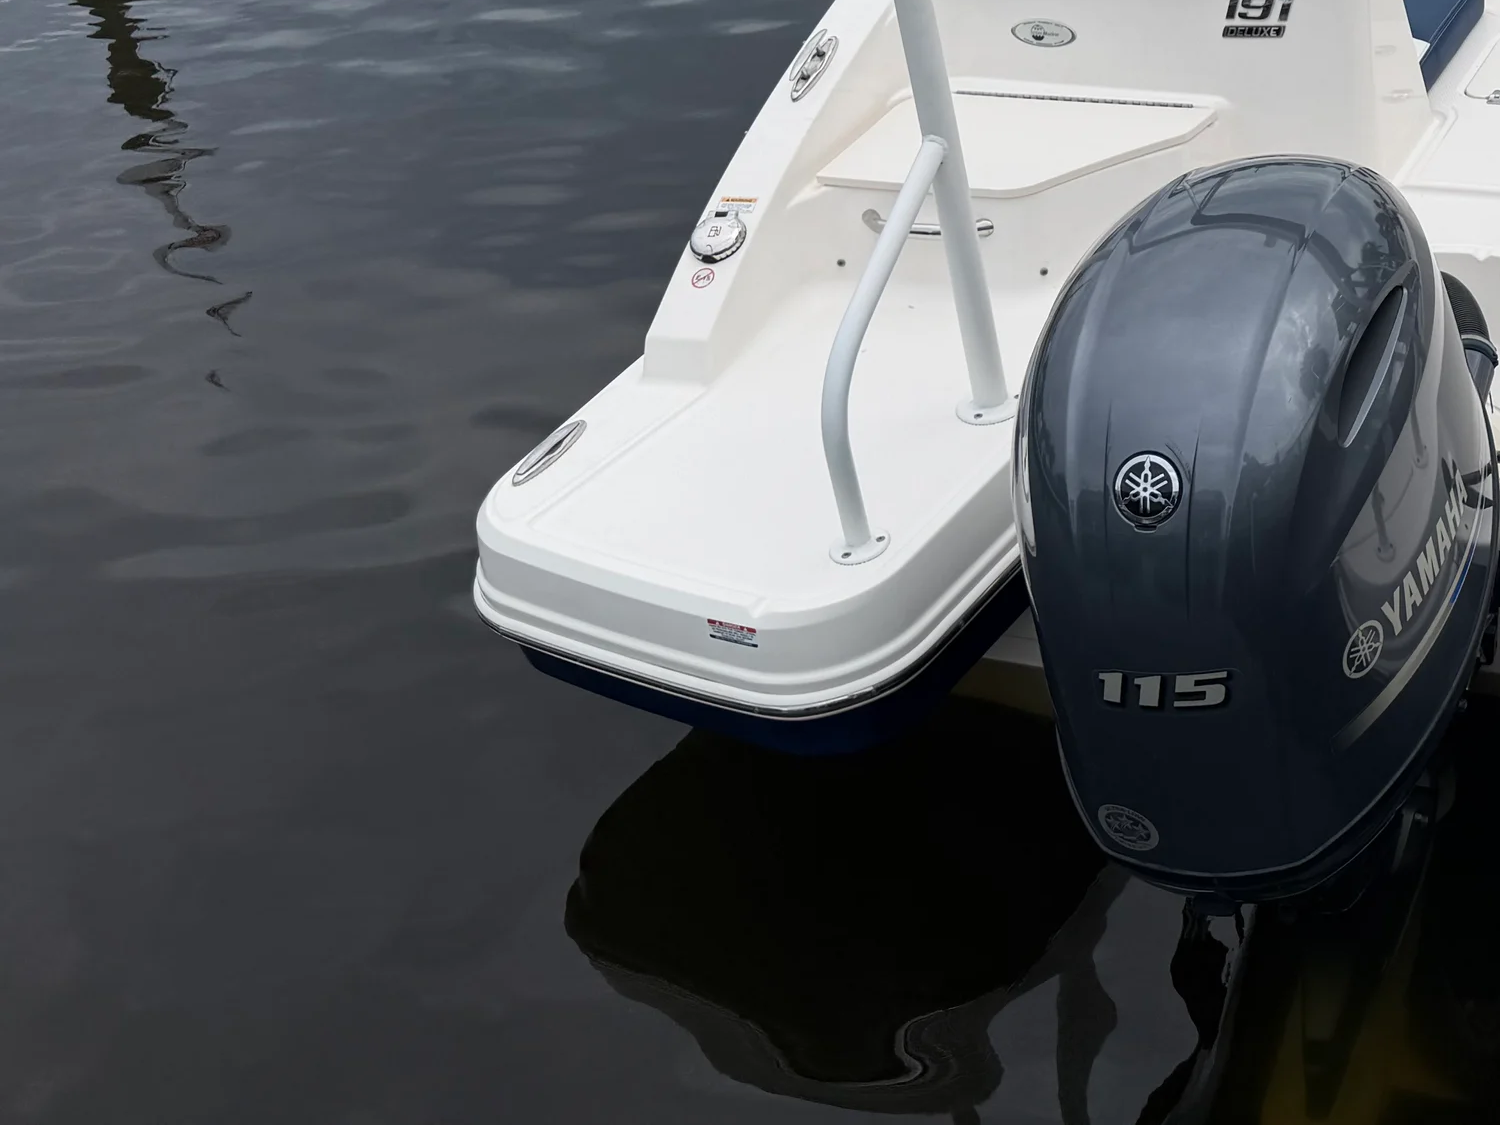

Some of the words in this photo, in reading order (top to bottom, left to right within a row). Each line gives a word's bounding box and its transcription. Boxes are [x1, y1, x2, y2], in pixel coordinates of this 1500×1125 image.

[1226, 26, 1281, 37] DELUXE
[1381, 469, 1468, 636] YAMAHA
[1098, 671, 1228, 707] 115
